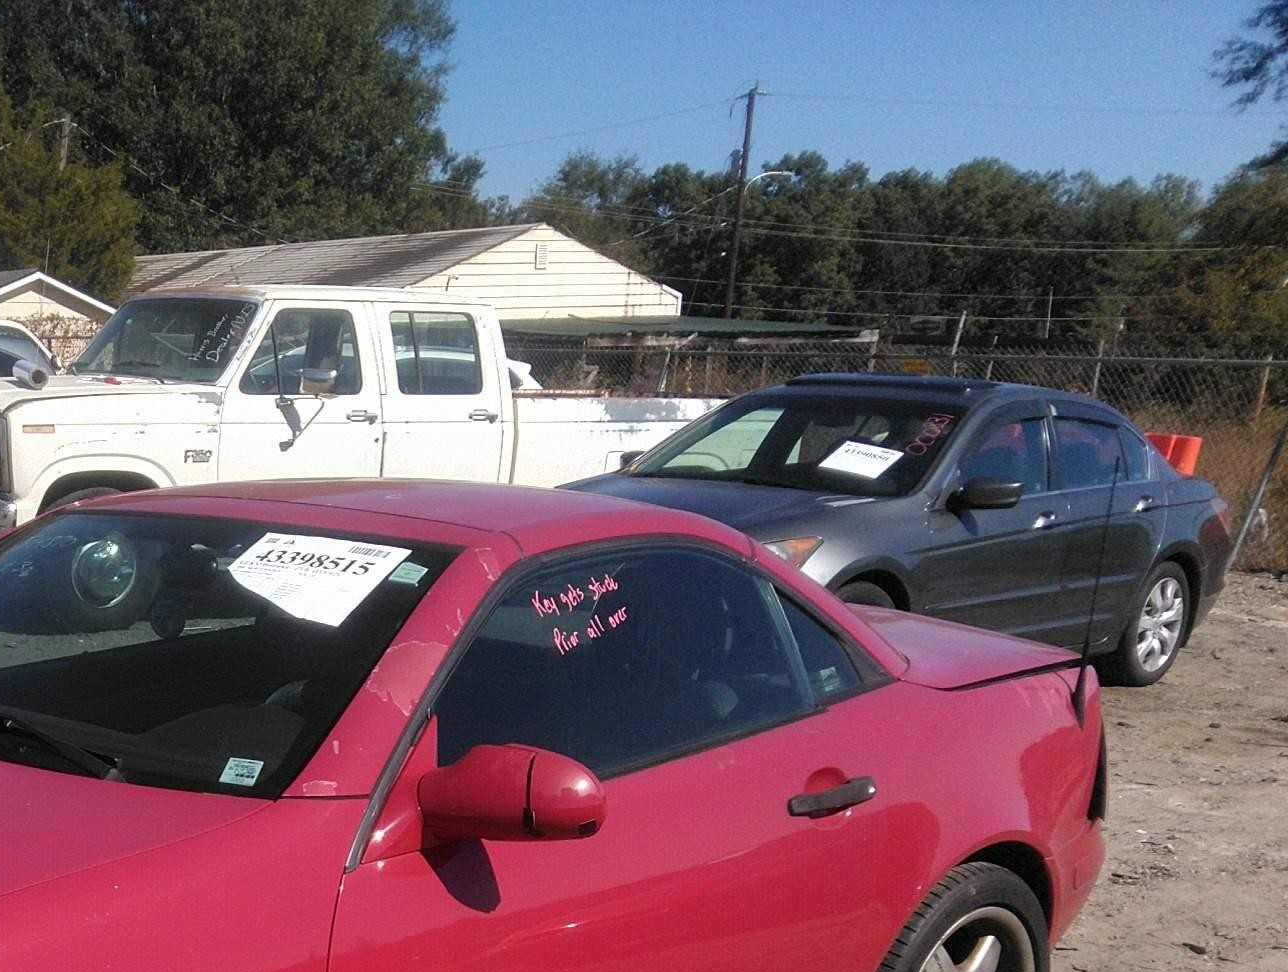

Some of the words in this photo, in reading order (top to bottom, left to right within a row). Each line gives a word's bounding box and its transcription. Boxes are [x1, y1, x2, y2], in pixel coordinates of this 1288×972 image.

[255, 549, 376, 575] 43398515
[531, 590, 561, 617] Key
[560, 583, 585, 612] gets
[587, 614, 605, 638] all
[608, 606, 628, 628] over
